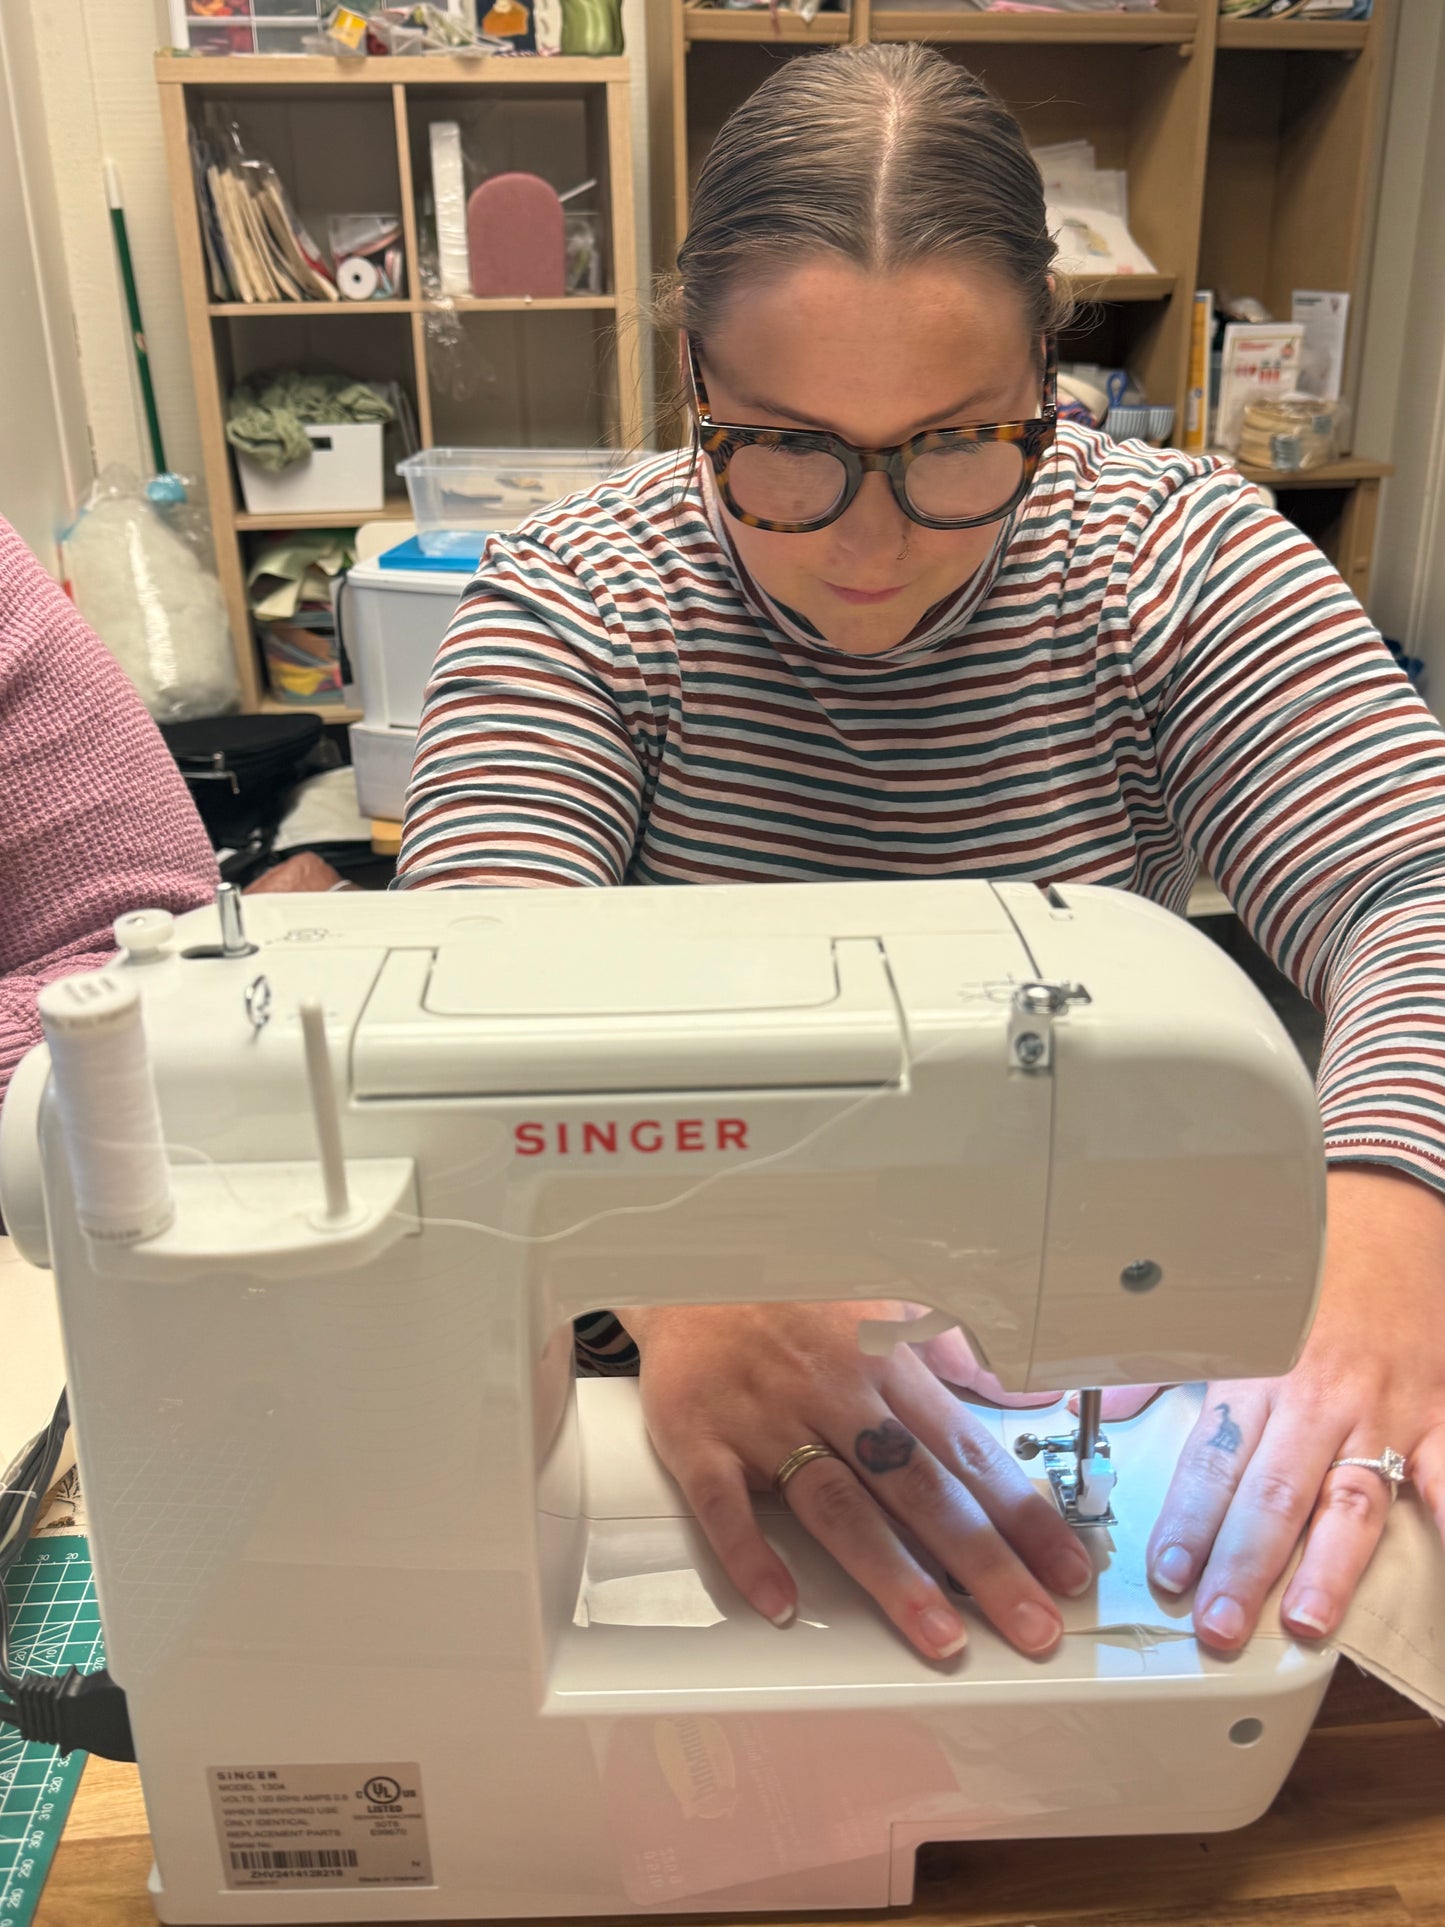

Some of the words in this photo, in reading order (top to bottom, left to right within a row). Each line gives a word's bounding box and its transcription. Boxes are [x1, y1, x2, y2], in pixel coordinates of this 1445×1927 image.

[514, 1118, 748, 1156] SINGER
[65, 1552, 79, 1560] 20
[45, 1649, 58, 1660] 10
[216, 1771, 277, 1780] SINGER
[47, 1776, 64, 1795] 320
[218, 1783, 255, 1791] MODEL
[221, 1795, 254, 1803] VOLTS
[38, 1803, 55, 1821] 310
[223, 1808, 255, 1816] WHEN
[257, 1807, 315, 1815] SERVICING
[317, 1806, 338, 1814] USE
[367, 1804, 403, 1813] LISTED
[224, 1820, 252, 1828] ONLY
[255, 1818, 309, 1826] IDENTICAL
[226, 1830, 303, 1838] REPLACEMENT
[306, 1829, 341, 1837] PARTS
[28, 1830, 45, 1849] 300
